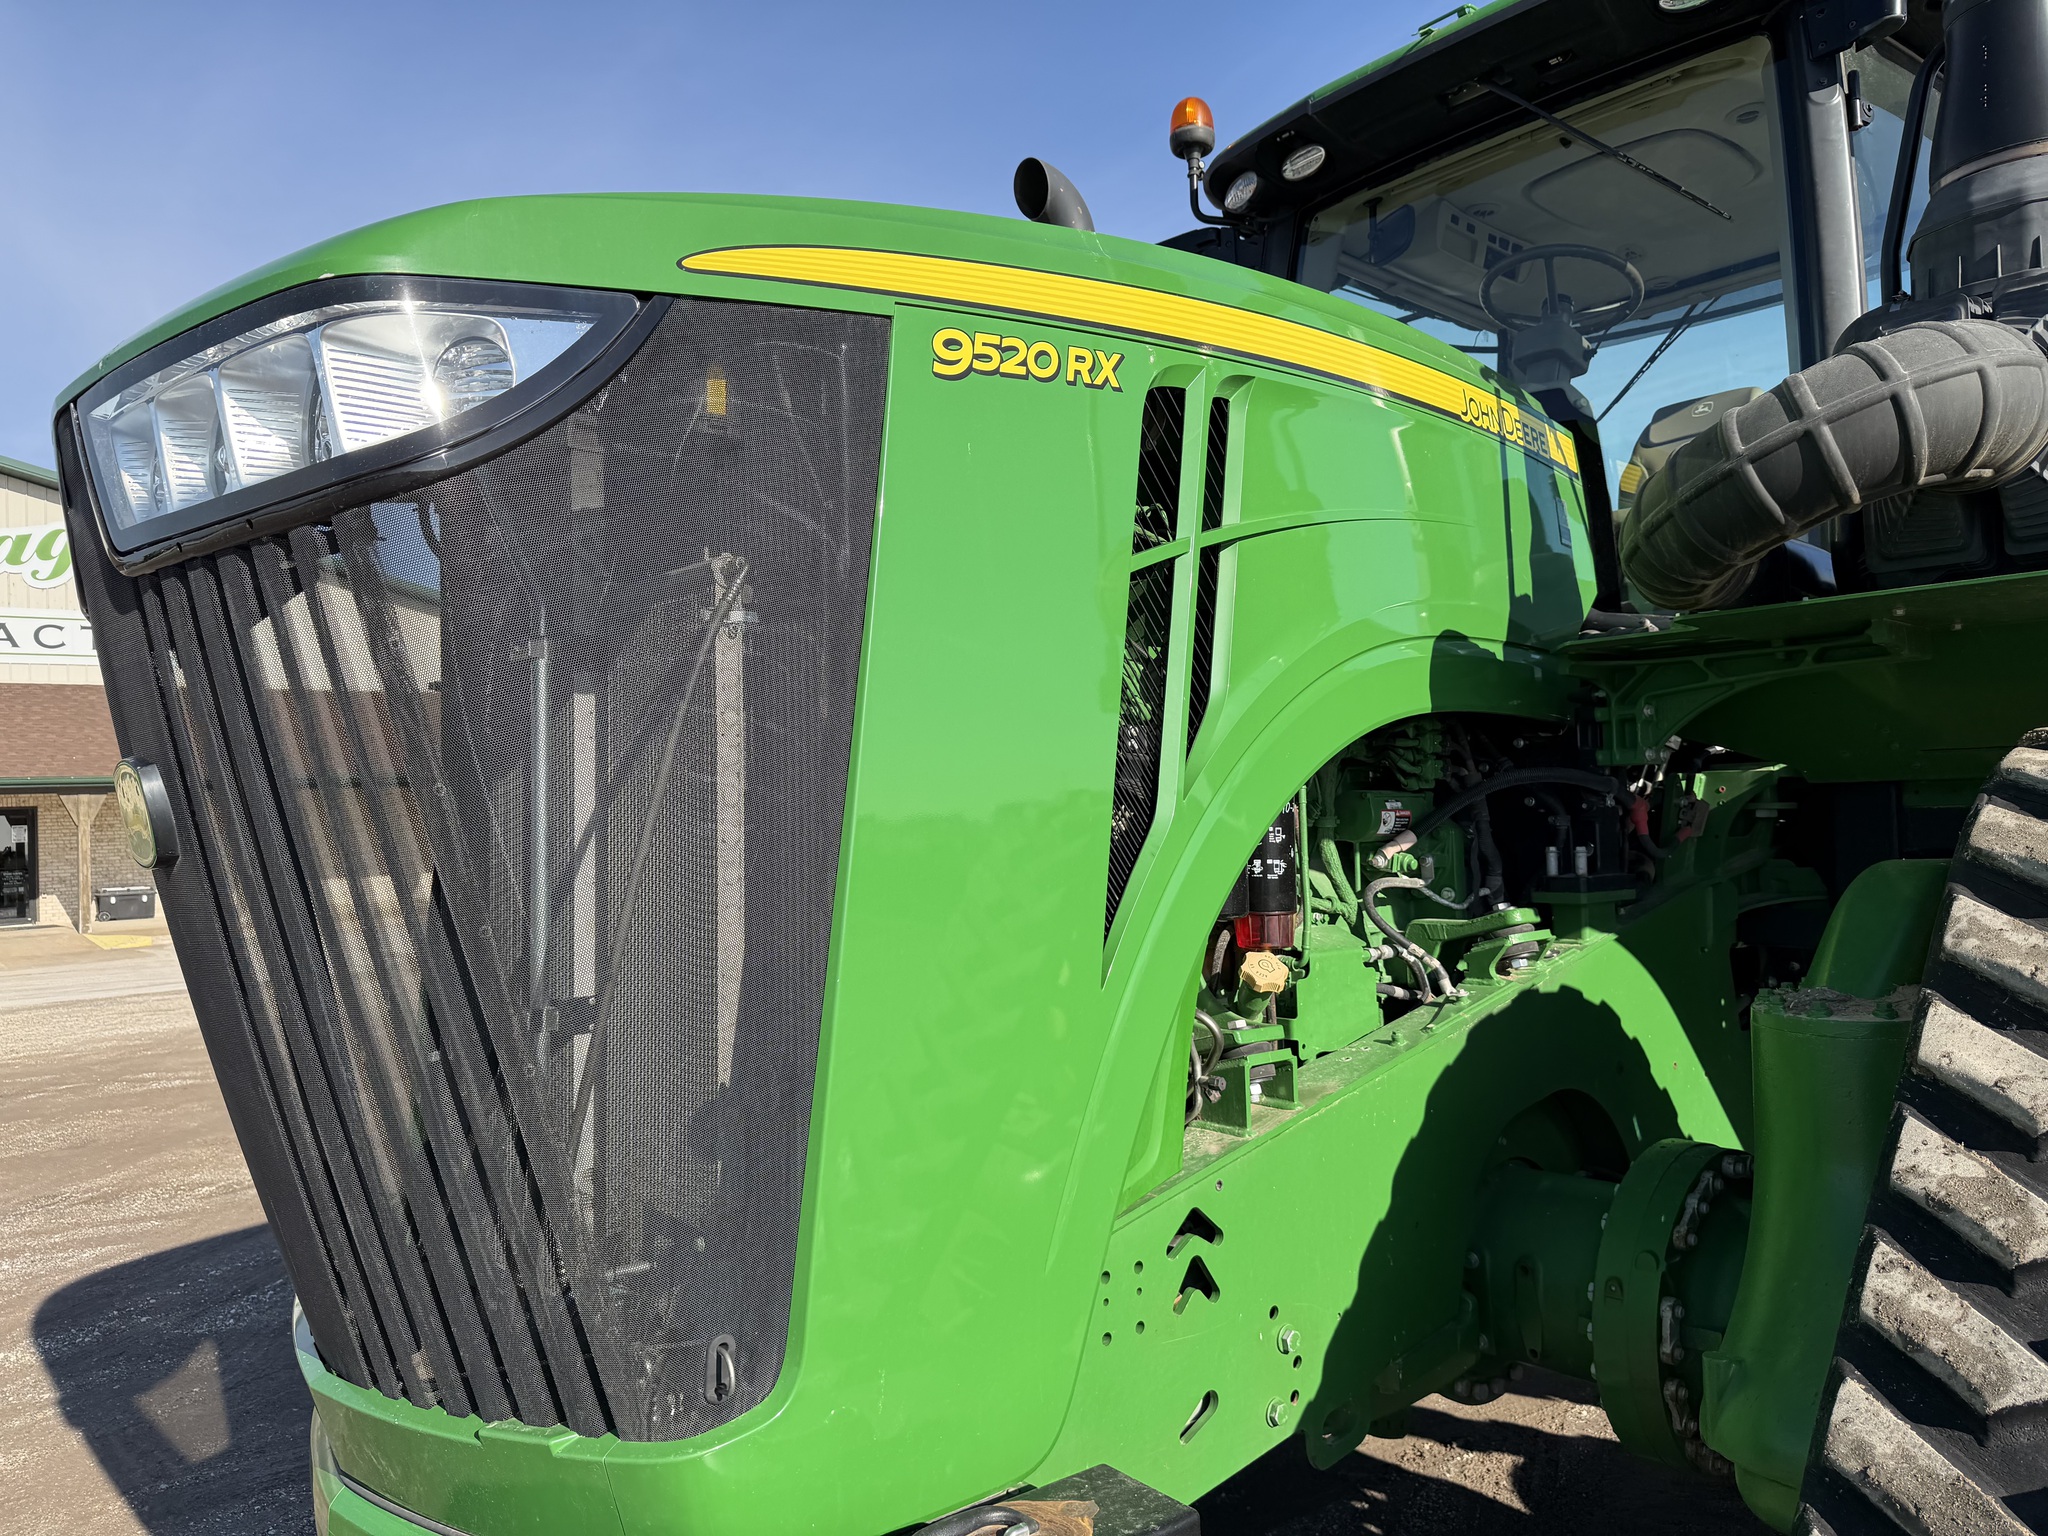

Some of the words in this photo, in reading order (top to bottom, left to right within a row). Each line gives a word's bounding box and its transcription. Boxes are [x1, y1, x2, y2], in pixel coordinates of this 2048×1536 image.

[932, 327, 1061, 383] 9520
[1066, 345, 1125, 393] RX
[1460, 388, 1501, 434] JOHN
[1501, 404, 1549, 457] DEERE
